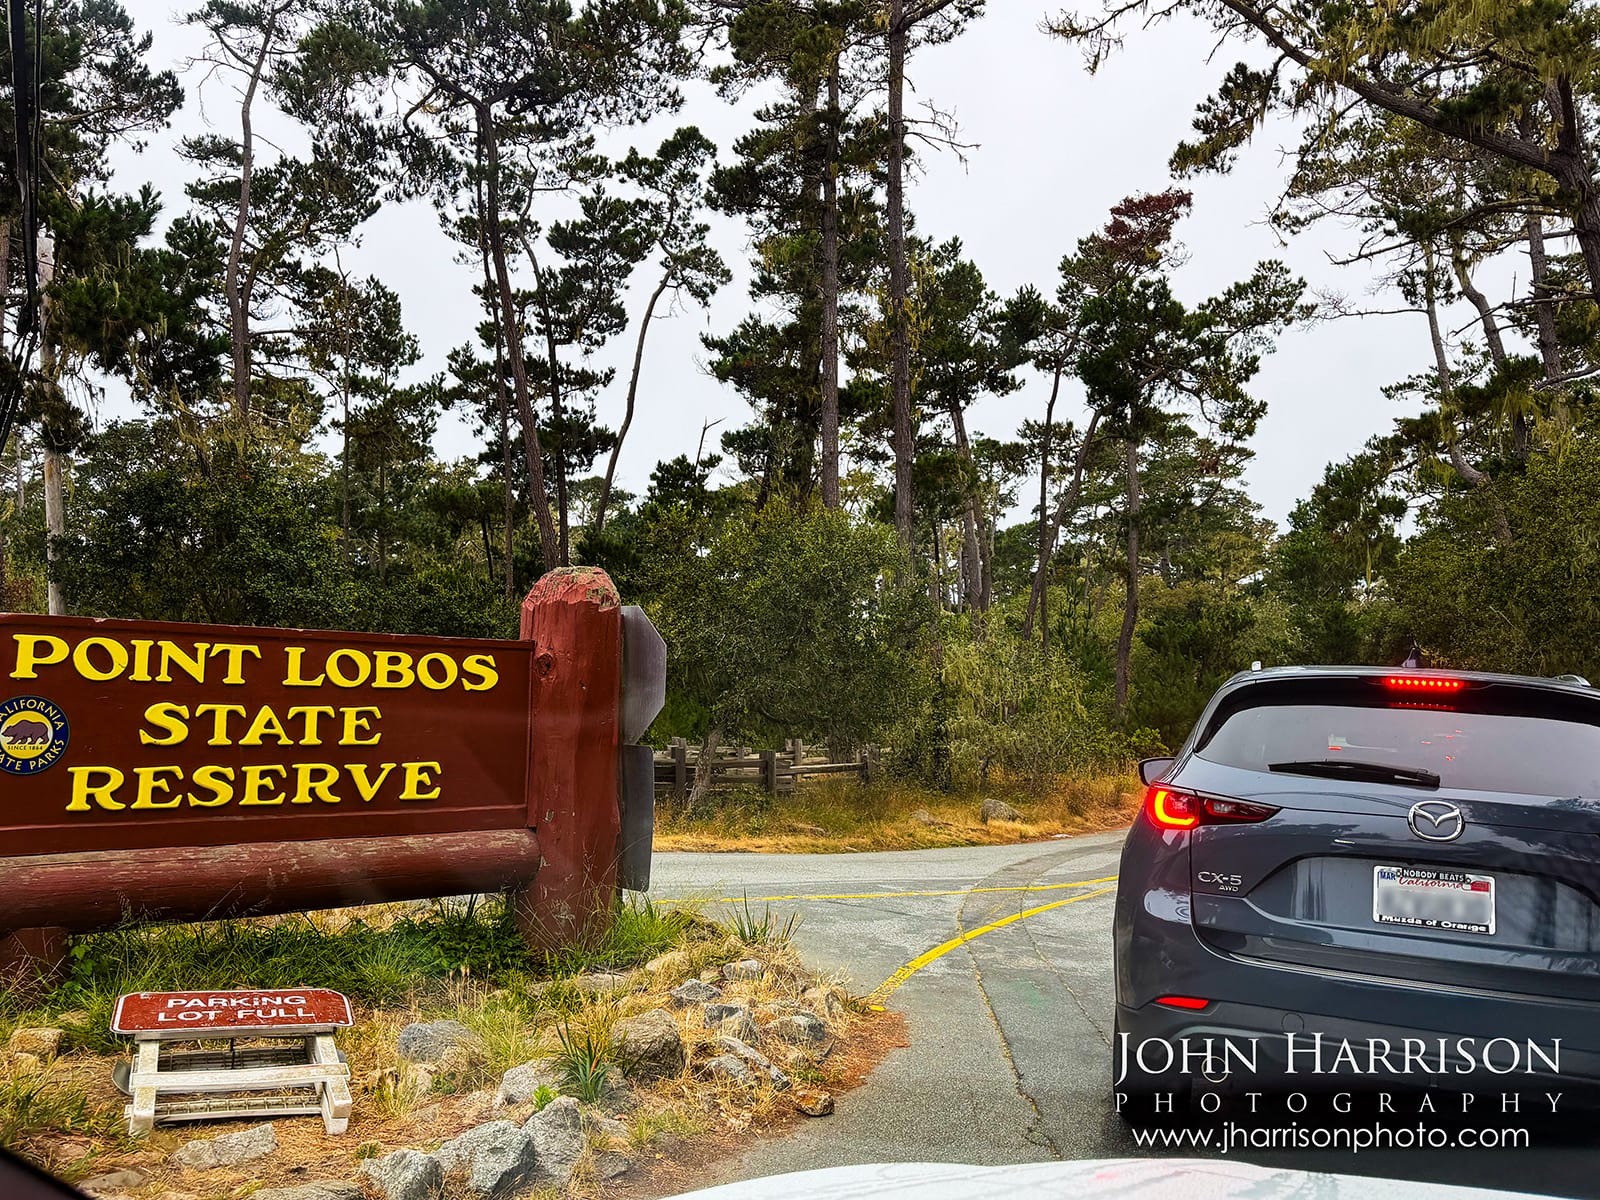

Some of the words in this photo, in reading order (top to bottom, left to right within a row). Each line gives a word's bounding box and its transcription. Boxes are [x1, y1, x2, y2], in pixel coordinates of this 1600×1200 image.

[9, 634, 262, 684] POINT
[282, 647, 499, 691] LOBOS
[0, 699, 65, 730] ALIFORNIA
[138, 702, 382, 746] STATE
[29, 739, 65, 770] PARKS
[65, 761, 442, 812] RESERVE
[1198, 871, 1242, 886] CX-5
[1403, 870, 1437, 879] NOBODY
[1439, 873, 1465, 882] BEATS
[1425, 919, 1438, 927] of
[1441, 920, 1487, 932] Orange
[167, 996, 306, 1009] PARKING
[158, 1010, 222, 1022] LOT
[237, 1008, 314, 1019] FULL
